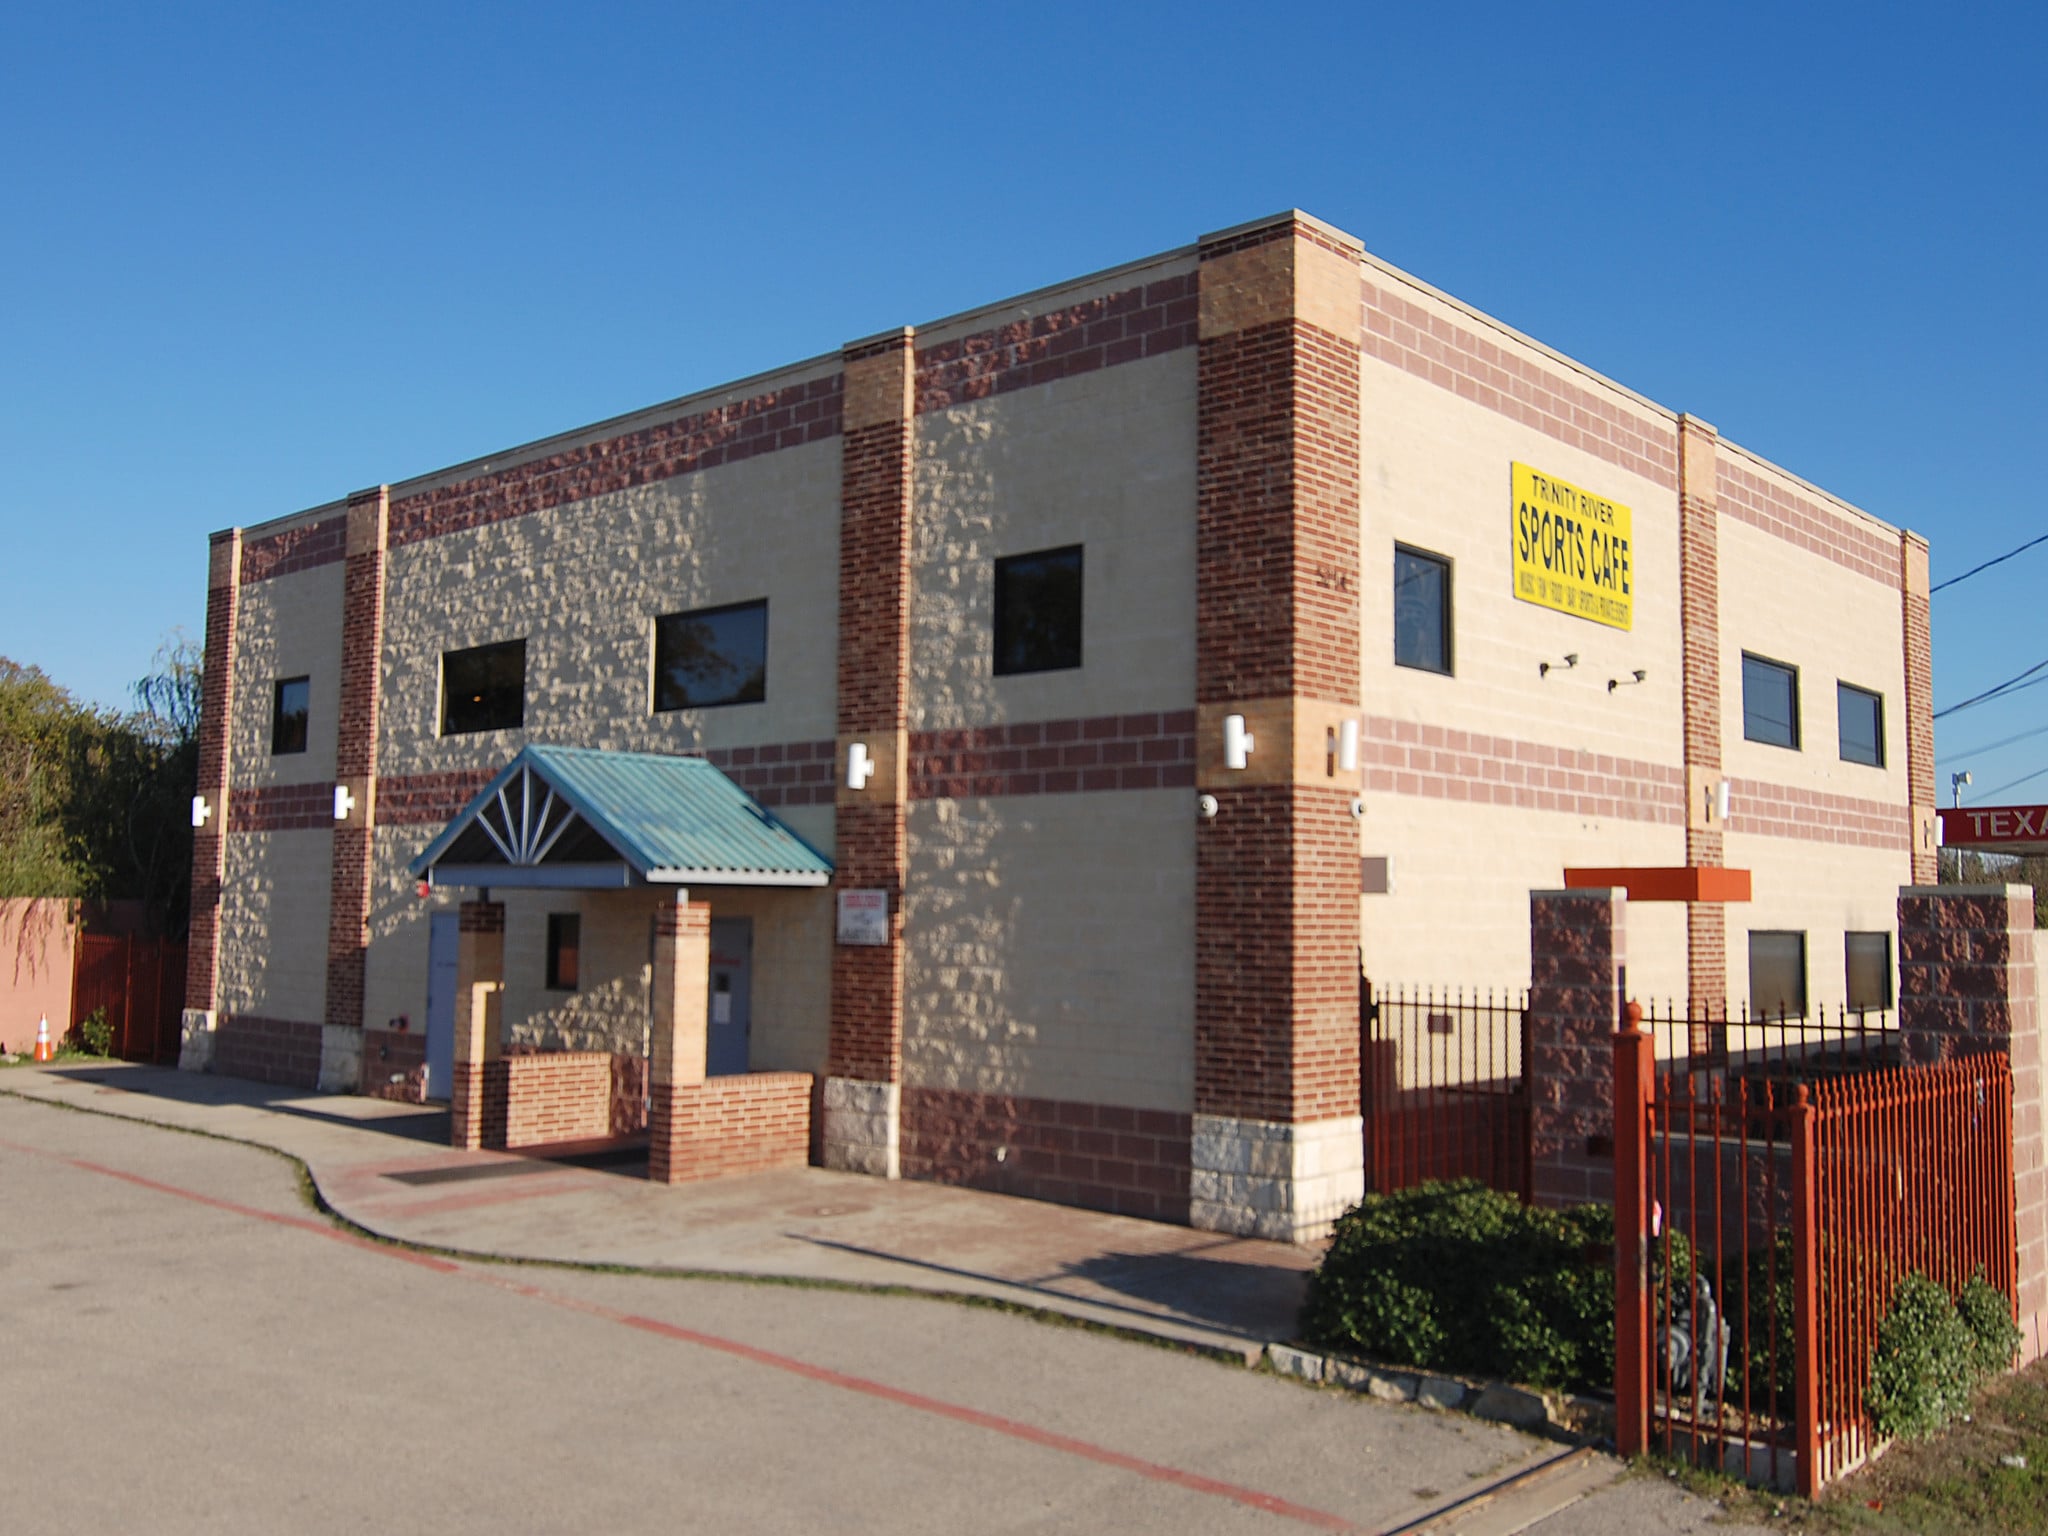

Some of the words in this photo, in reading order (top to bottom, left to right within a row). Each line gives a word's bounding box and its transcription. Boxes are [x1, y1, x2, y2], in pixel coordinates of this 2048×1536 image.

[1532, 474, 1577, 512] TRINITY
[1580, 495, 1614, 526] RIVER
[1519, 501, 1586, 581] SPORTS
[1591, 528, 1629, 595] CAFE
